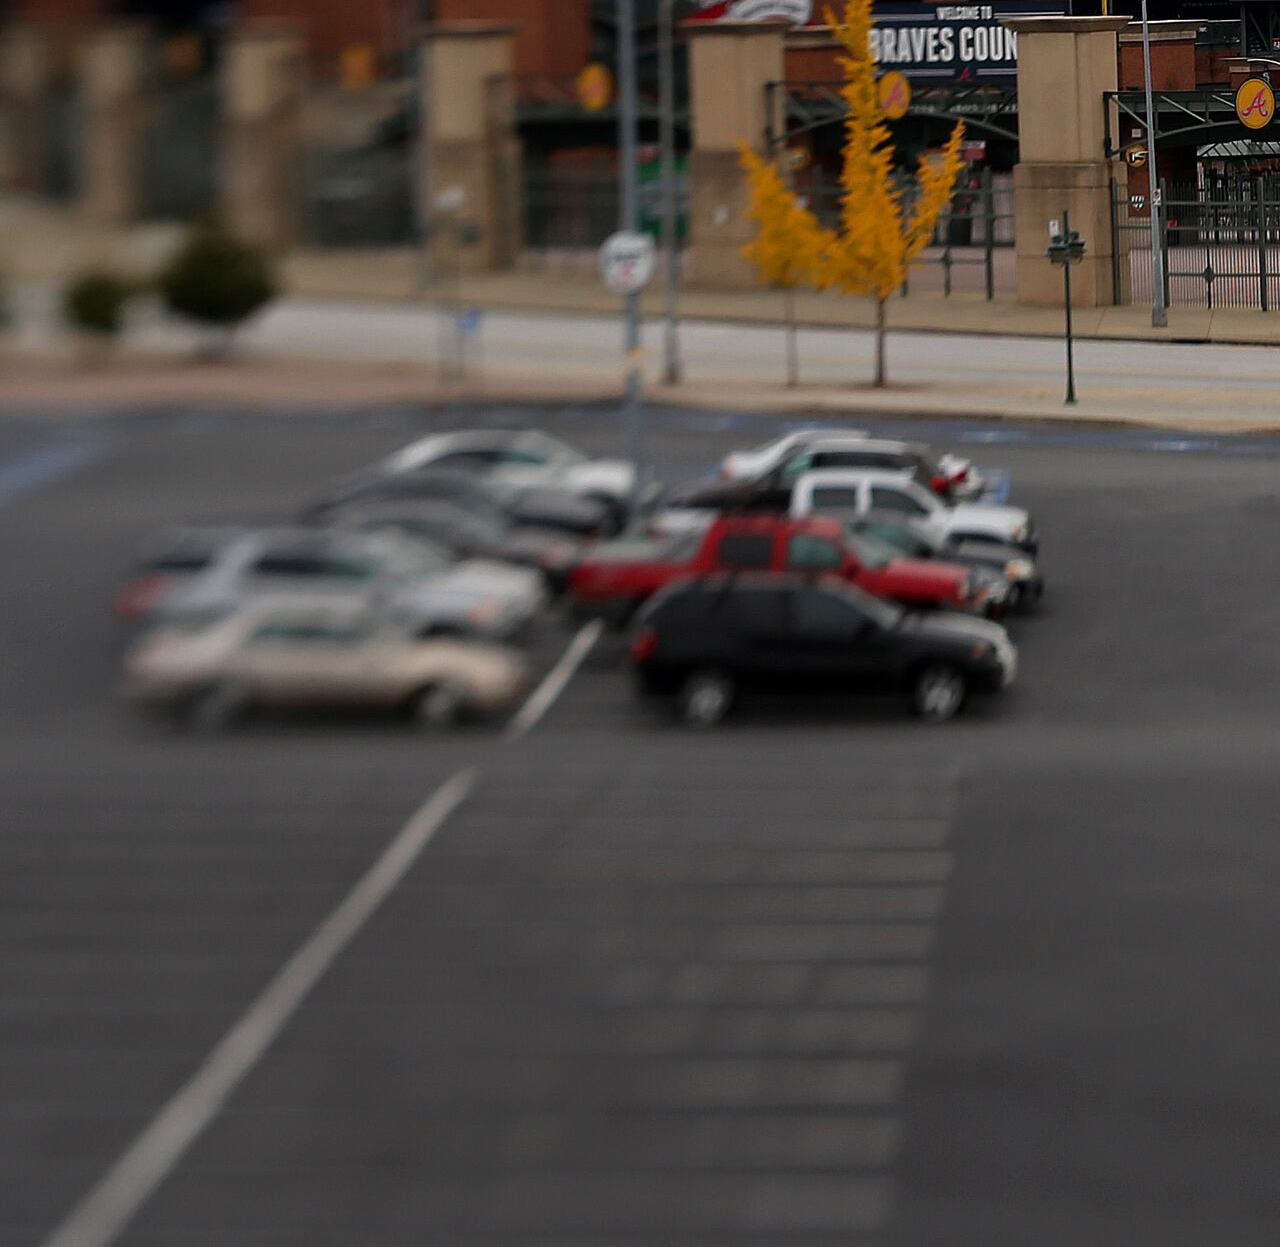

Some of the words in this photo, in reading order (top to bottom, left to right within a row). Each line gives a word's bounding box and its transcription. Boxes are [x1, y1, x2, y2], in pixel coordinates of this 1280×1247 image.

[936, 5, 979, 21] WELCOME
[980, 5, 993, 19] TO
[868, 26, 955, 64] BRAVES
